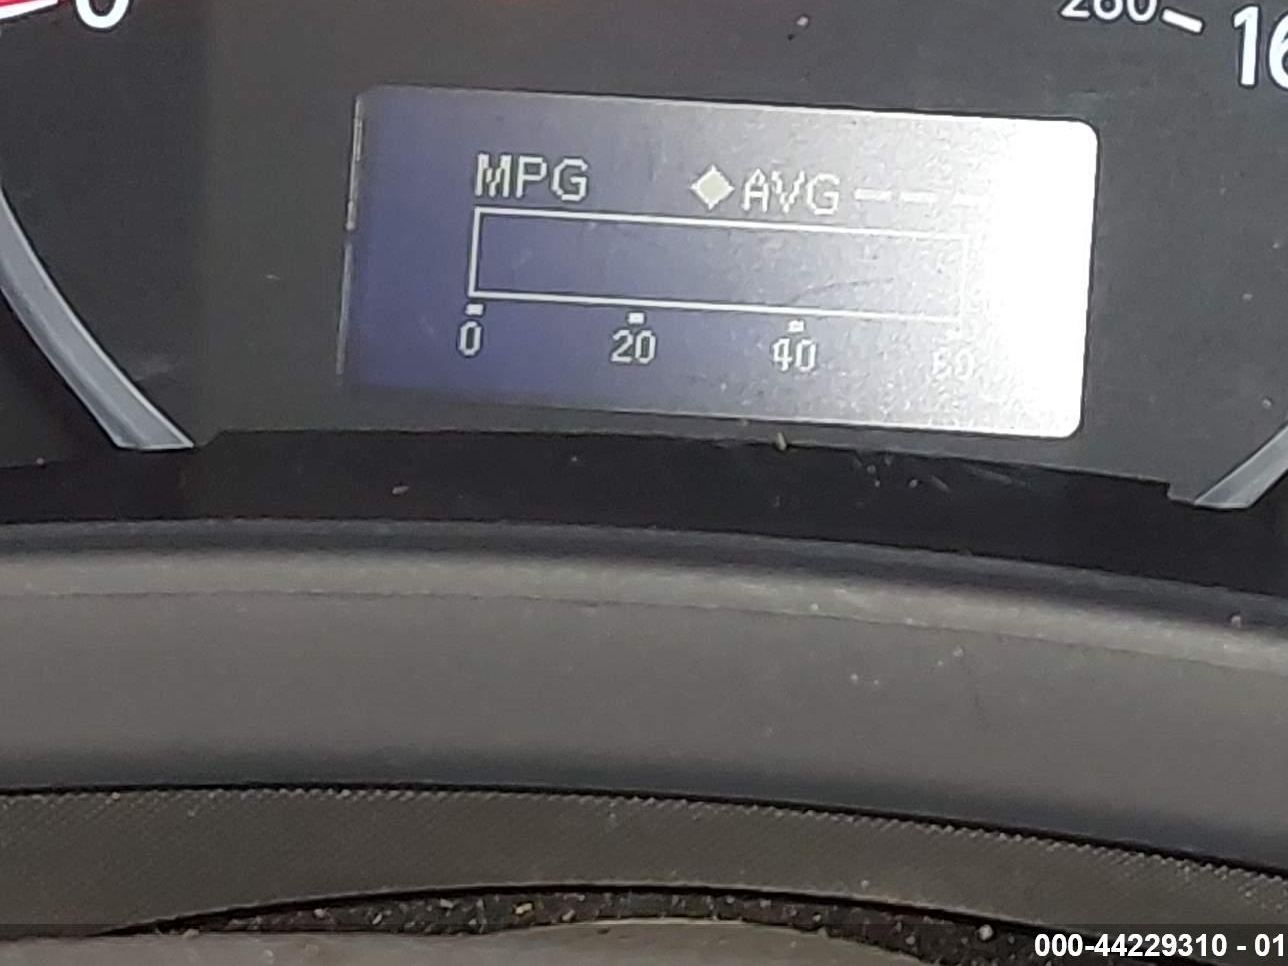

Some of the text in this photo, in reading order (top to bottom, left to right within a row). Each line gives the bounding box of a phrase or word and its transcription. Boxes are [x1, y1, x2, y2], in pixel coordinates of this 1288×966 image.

[474, 153, 588, 202] MPG
[457, 321, 482, 356] 0
[611, 329, 657, 365] 20
[771, 336, 818, 373] 40
